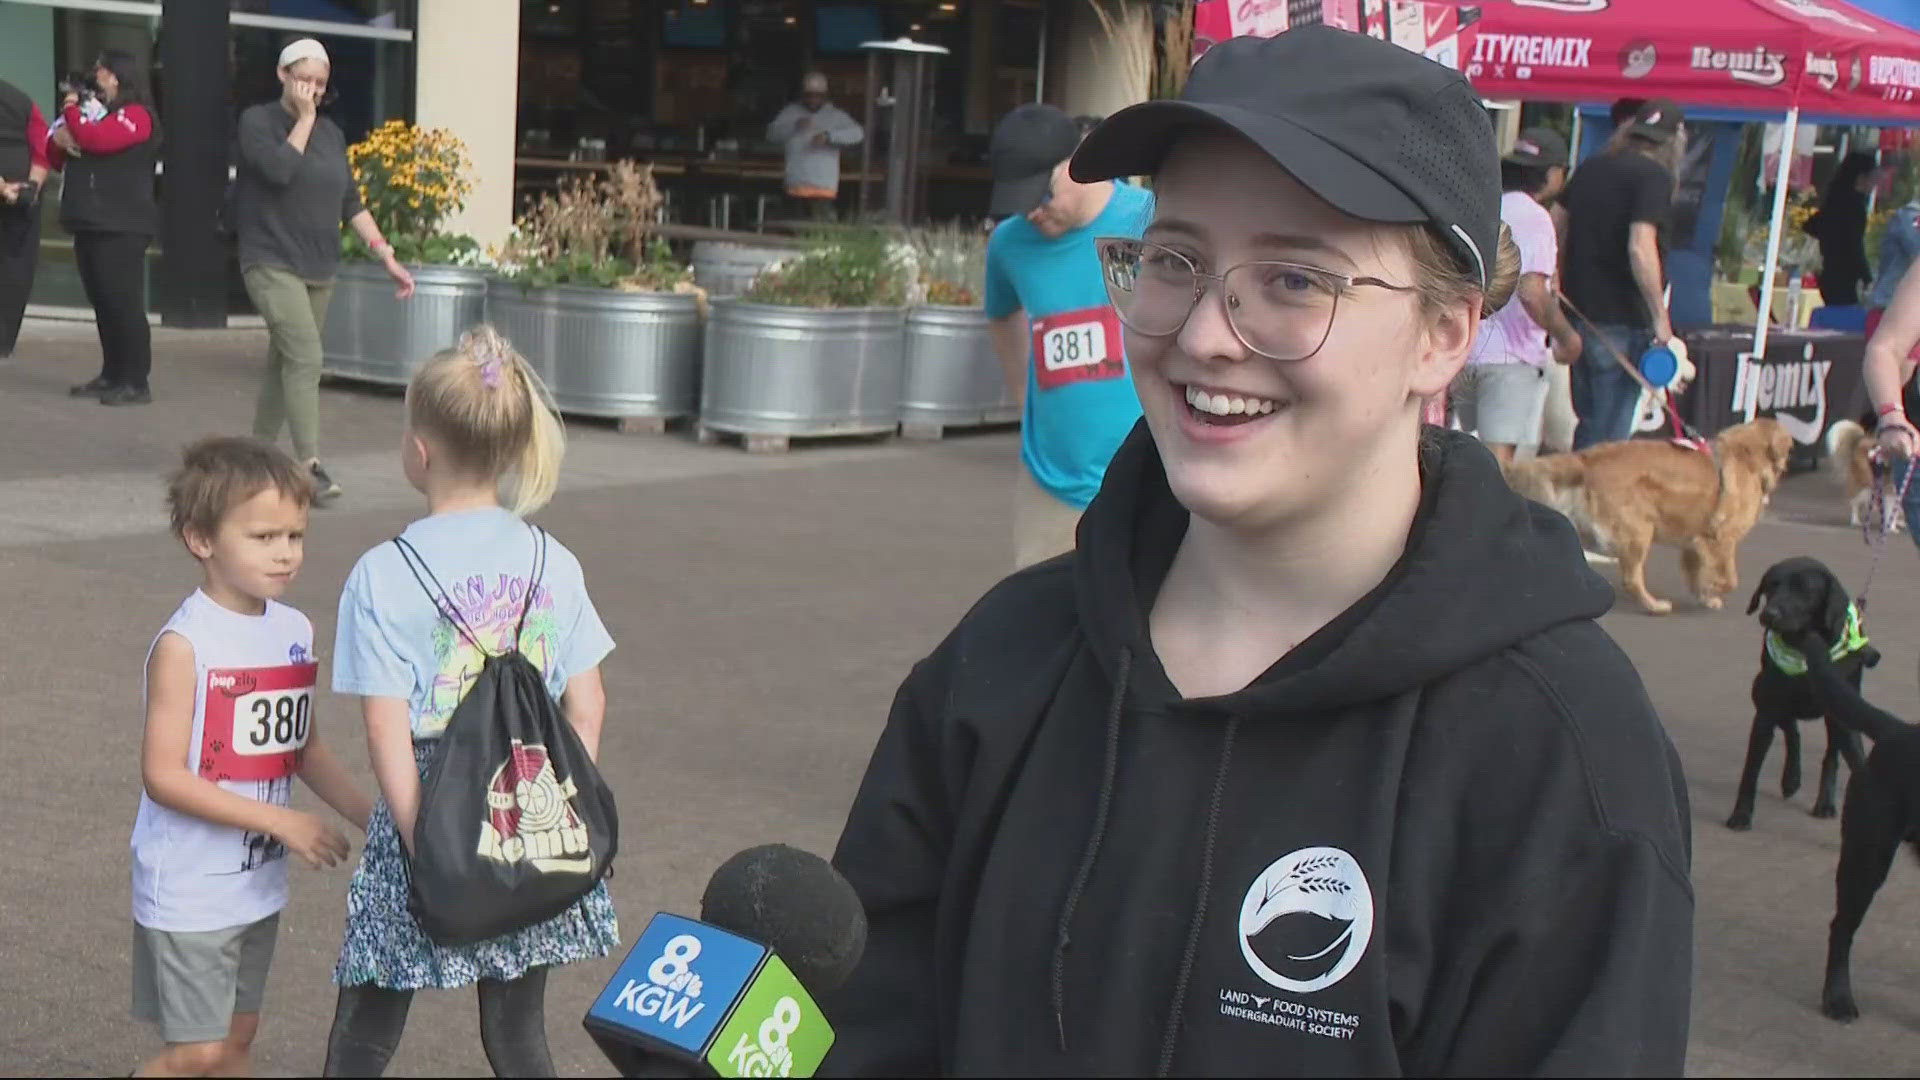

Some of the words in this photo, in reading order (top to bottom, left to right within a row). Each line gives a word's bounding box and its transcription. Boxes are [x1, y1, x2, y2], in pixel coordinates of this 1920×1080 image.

[1691, 46, 1785, 86] Remix
[1052, 329, 1093, 363] 381
[249, 693, 309, 747] 380
[648, 934, 702, 987] 8
[613, 978, 705, 1030] KGW
[758, 995, 801, 1056] 8
[1219, 988, 1250, 1005] LAND
[1273, 998, 1306, 1017] FOOD
[1306, 1006, 1360, 1028] SYSTEMS
[1220, 1003, 1306, 1032] UNDERGRADUATE
[1308, 1022, 1355, 1041] SOCIETY
[727, 1032, 774, 1077] KG
